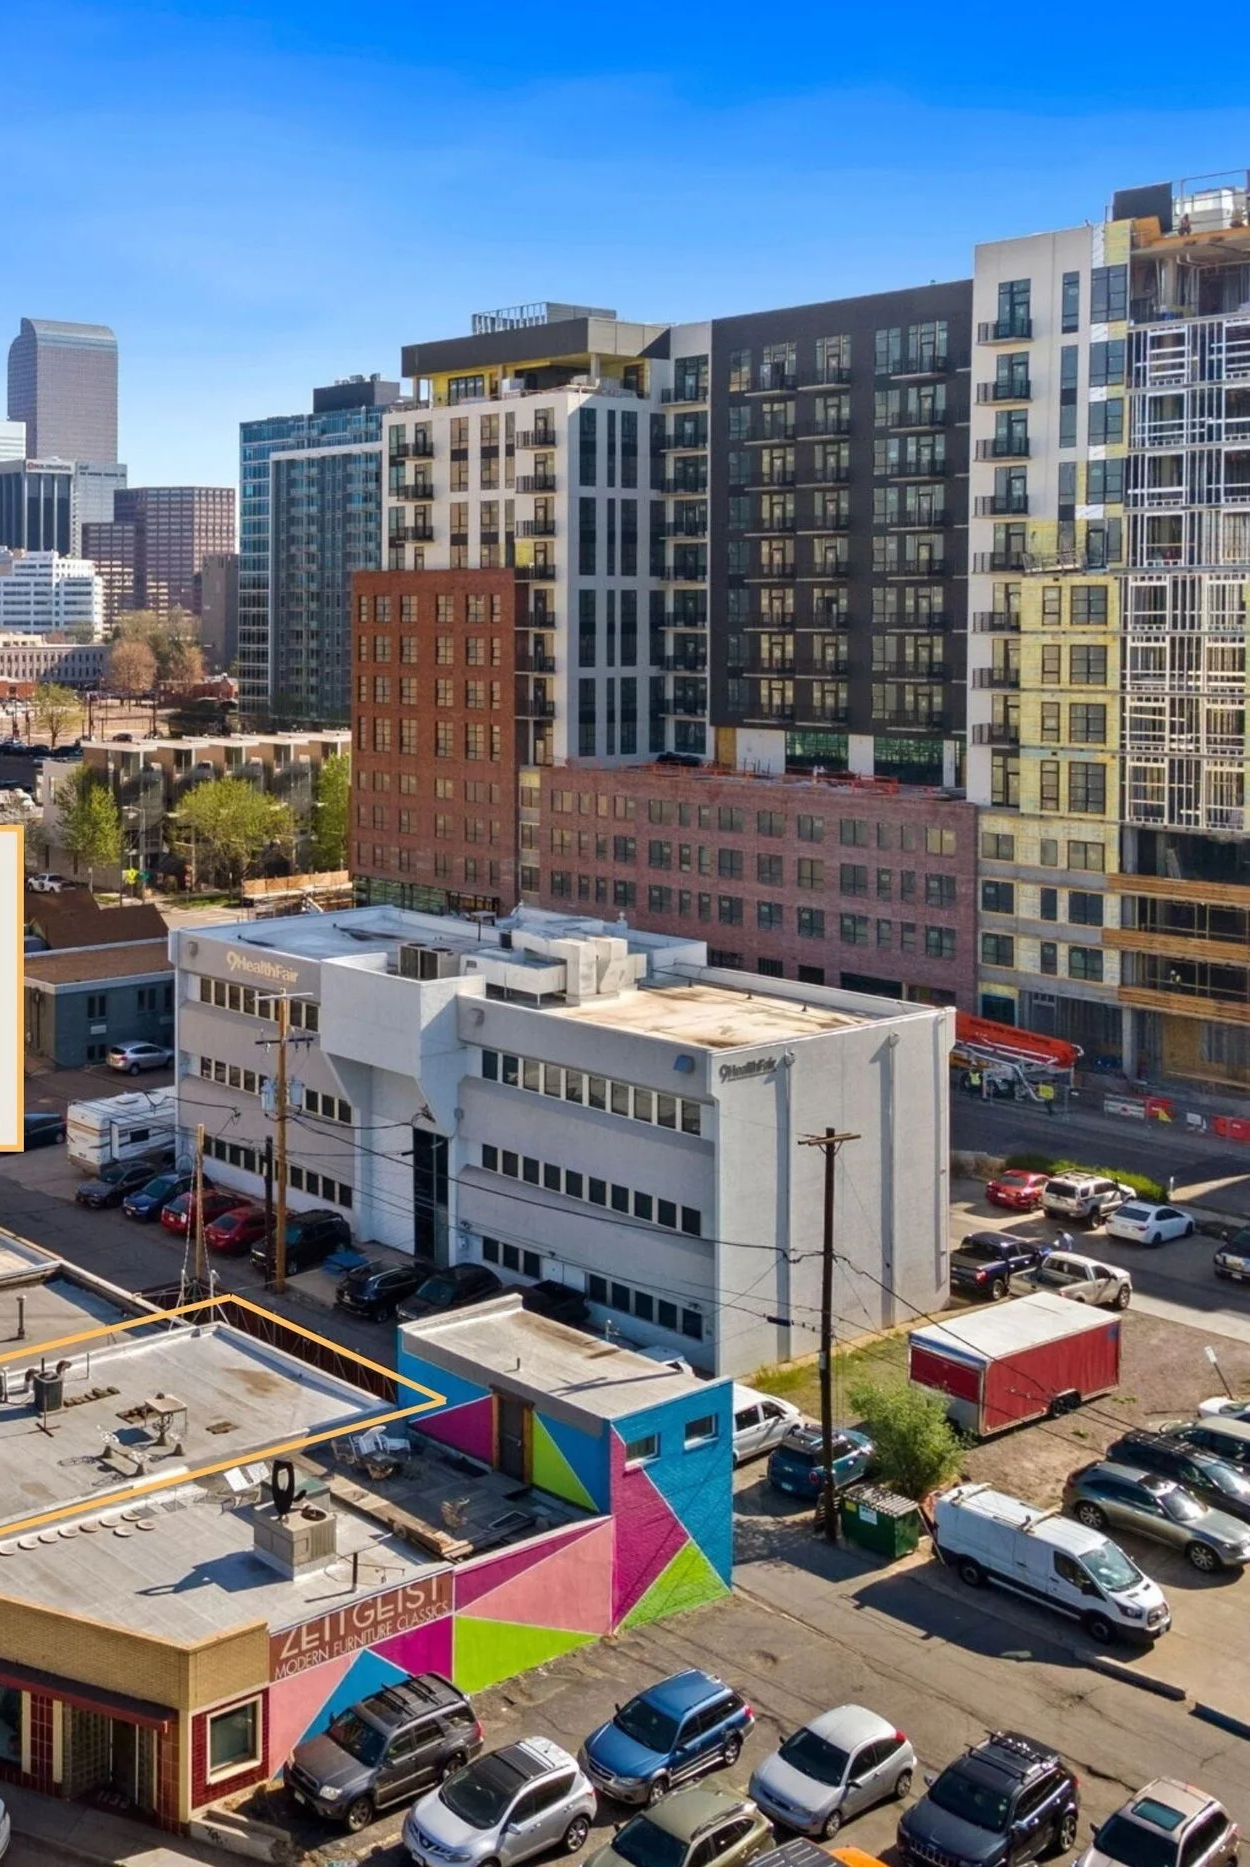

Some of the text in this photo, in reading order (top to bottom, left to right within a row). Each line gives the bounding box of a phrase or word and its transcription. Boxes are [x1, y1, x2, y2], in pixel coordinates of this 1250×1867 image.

[226, 951, 299, 983] 9HealthFair
[274, 1601, 448, 1681] MODERN FURNITURE CLASSICS
